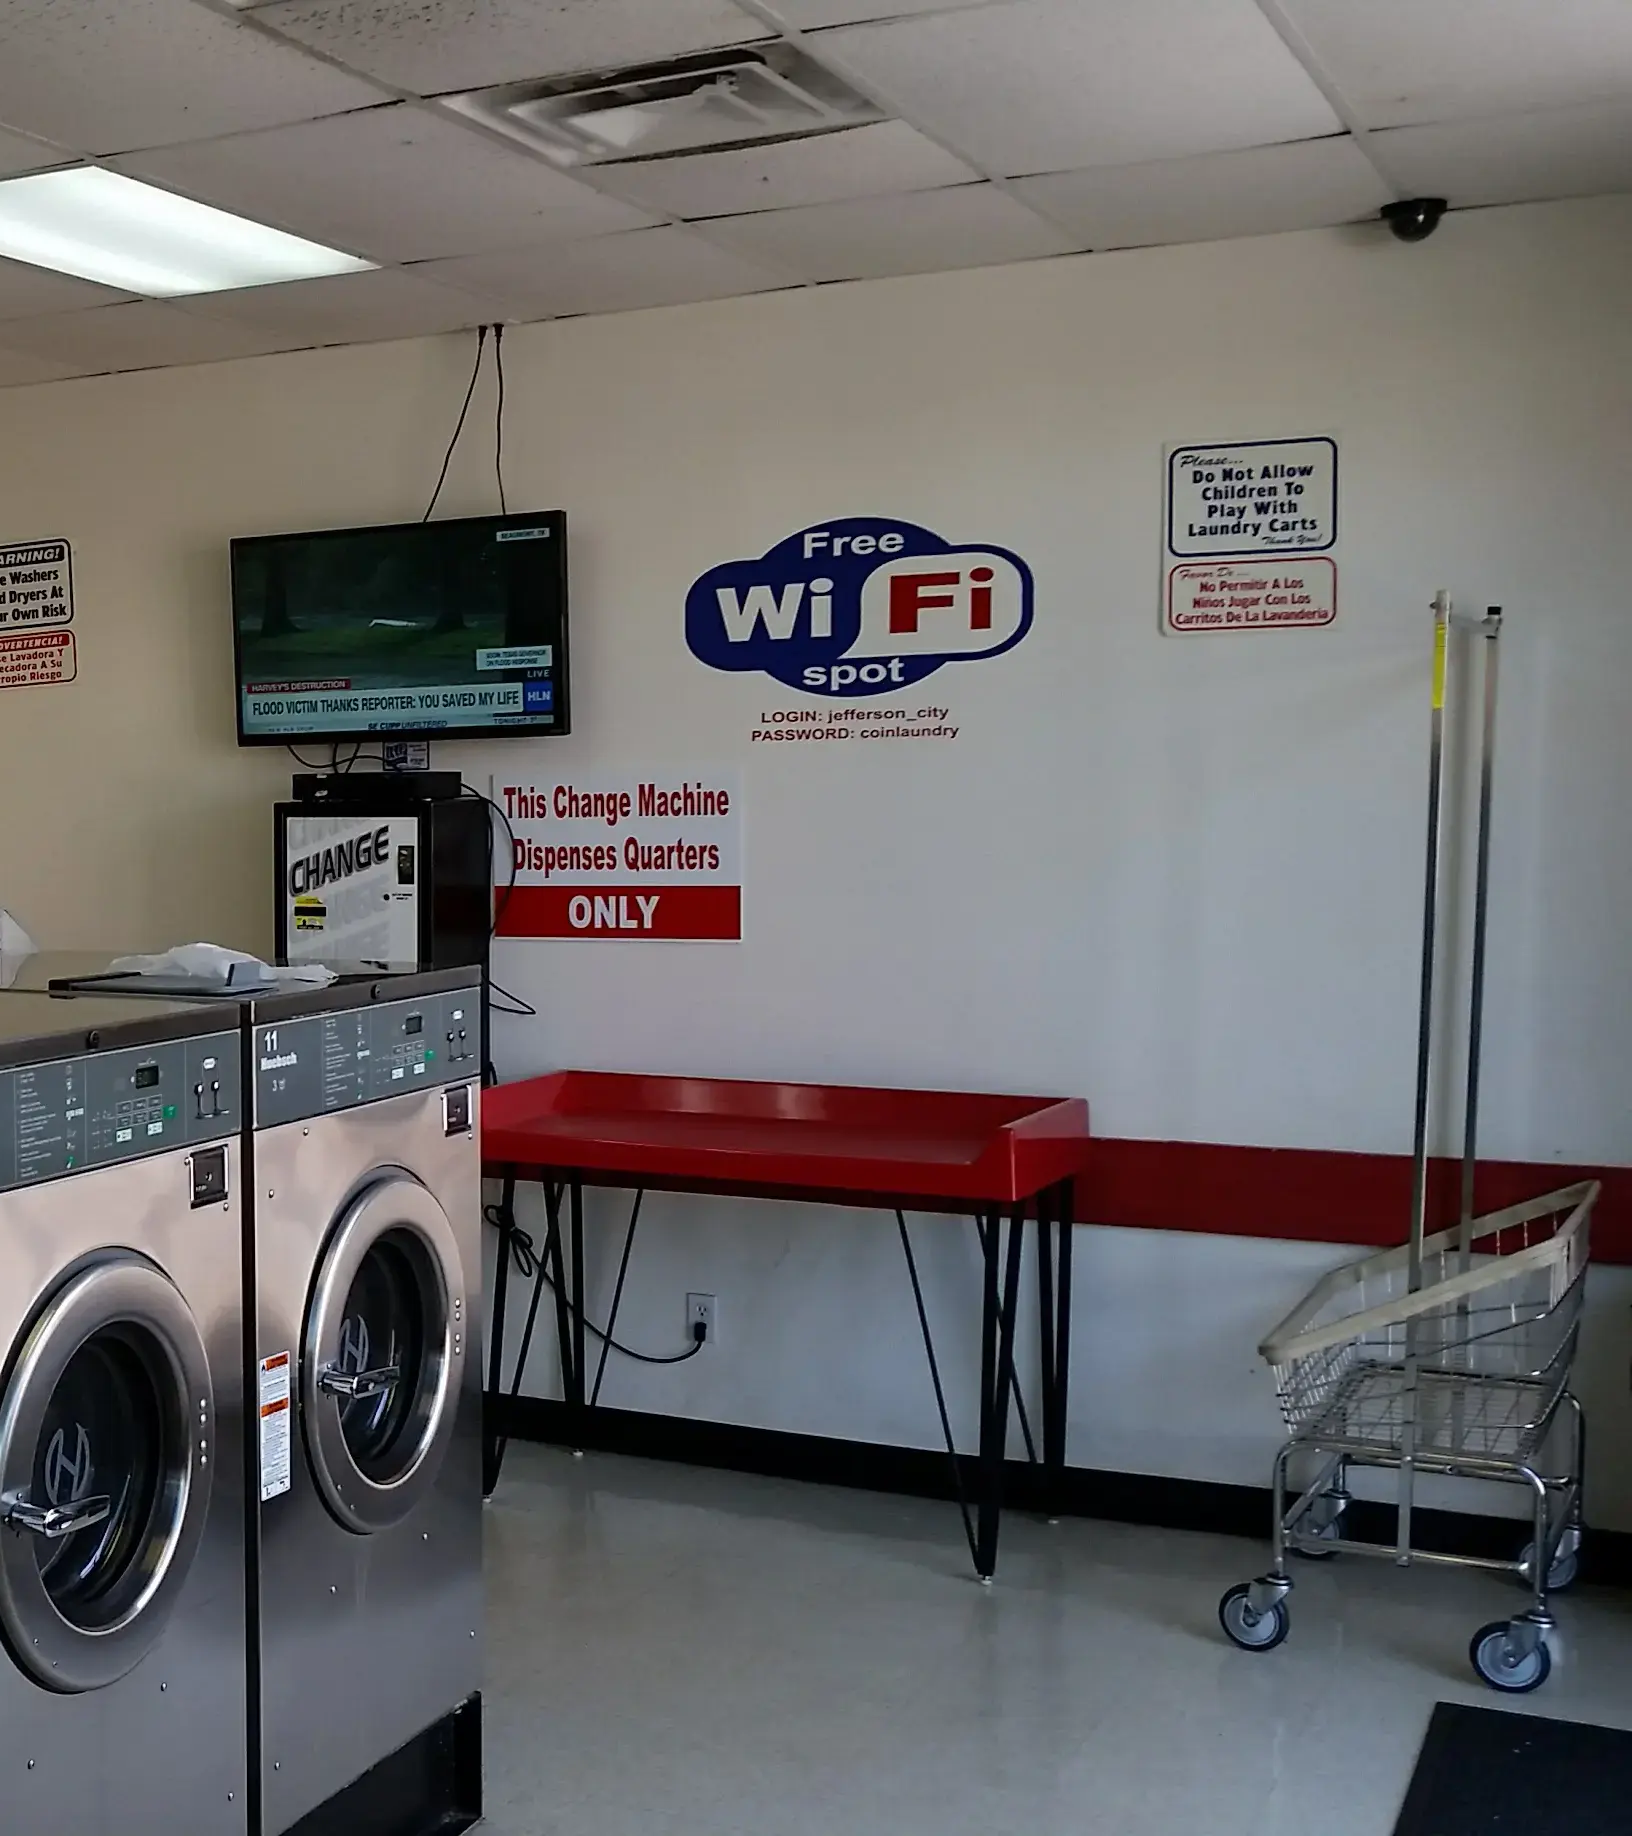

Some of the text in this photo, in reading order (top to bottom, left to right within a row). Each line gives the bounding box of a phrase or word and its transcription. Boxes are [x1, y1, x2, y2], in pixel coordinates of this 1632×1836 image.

[1192, 465, 1313, 483] Do Not Allow
[1202, 483, 1304, 500] Children To
[1208, 501, 1297, 519] Play With
[1189, 519, 1317, 537] Laundry Carts
[804, 531, 904, 559] Free
[9, 570, 58, 584] Washers
[1200, 578, 1304, 592] No Permitir A Los
[9, 590, 47, 604] Dryers
[51, 586, 64, 598] At
[1229, 596, 1260, 608] Jugar
[1265, 595, 1287, 605] Con
[1292, 594, 1311, 604] Los
[12, 609, 39, 621] Own
[42, 604, 66, 617] Risk
[716, 566, 994, 642] Wi Fi
[1176, 613, 1222, 625] Carritos
[1227, 612, 1241, 622] De
[1246, 611, 1259, 621] La
[10, 650, 54, 661] Lavadora
[51, 659, 62, 667] Su
[30, 671, 61, 680] Riesgo
[527, 669, 549, 677] LIVE
[803, 657, 904, 691] spot
[252, 681, 345, 692] HARVEY'S DESTRUCTION
[253, 690, 519, 715] FLOOD VICTIM THANKS REPORTER: YOU SAVED MY LIFE
[528, 691, 550, 701] HLN
[761, 707, 948, 723] LOGIN: jefferson_city
[752, 725, 959, 741] PASSWORD: coinlaundry
[504, 783, 729, 826] This Change Machine
[290, 825, 390, 897] CHANGE
[513, 837, 720, 878] Dispenses Quarters
[569, 895, 660, 929] ONLY
[265, 1030, 277, 1051] 11
